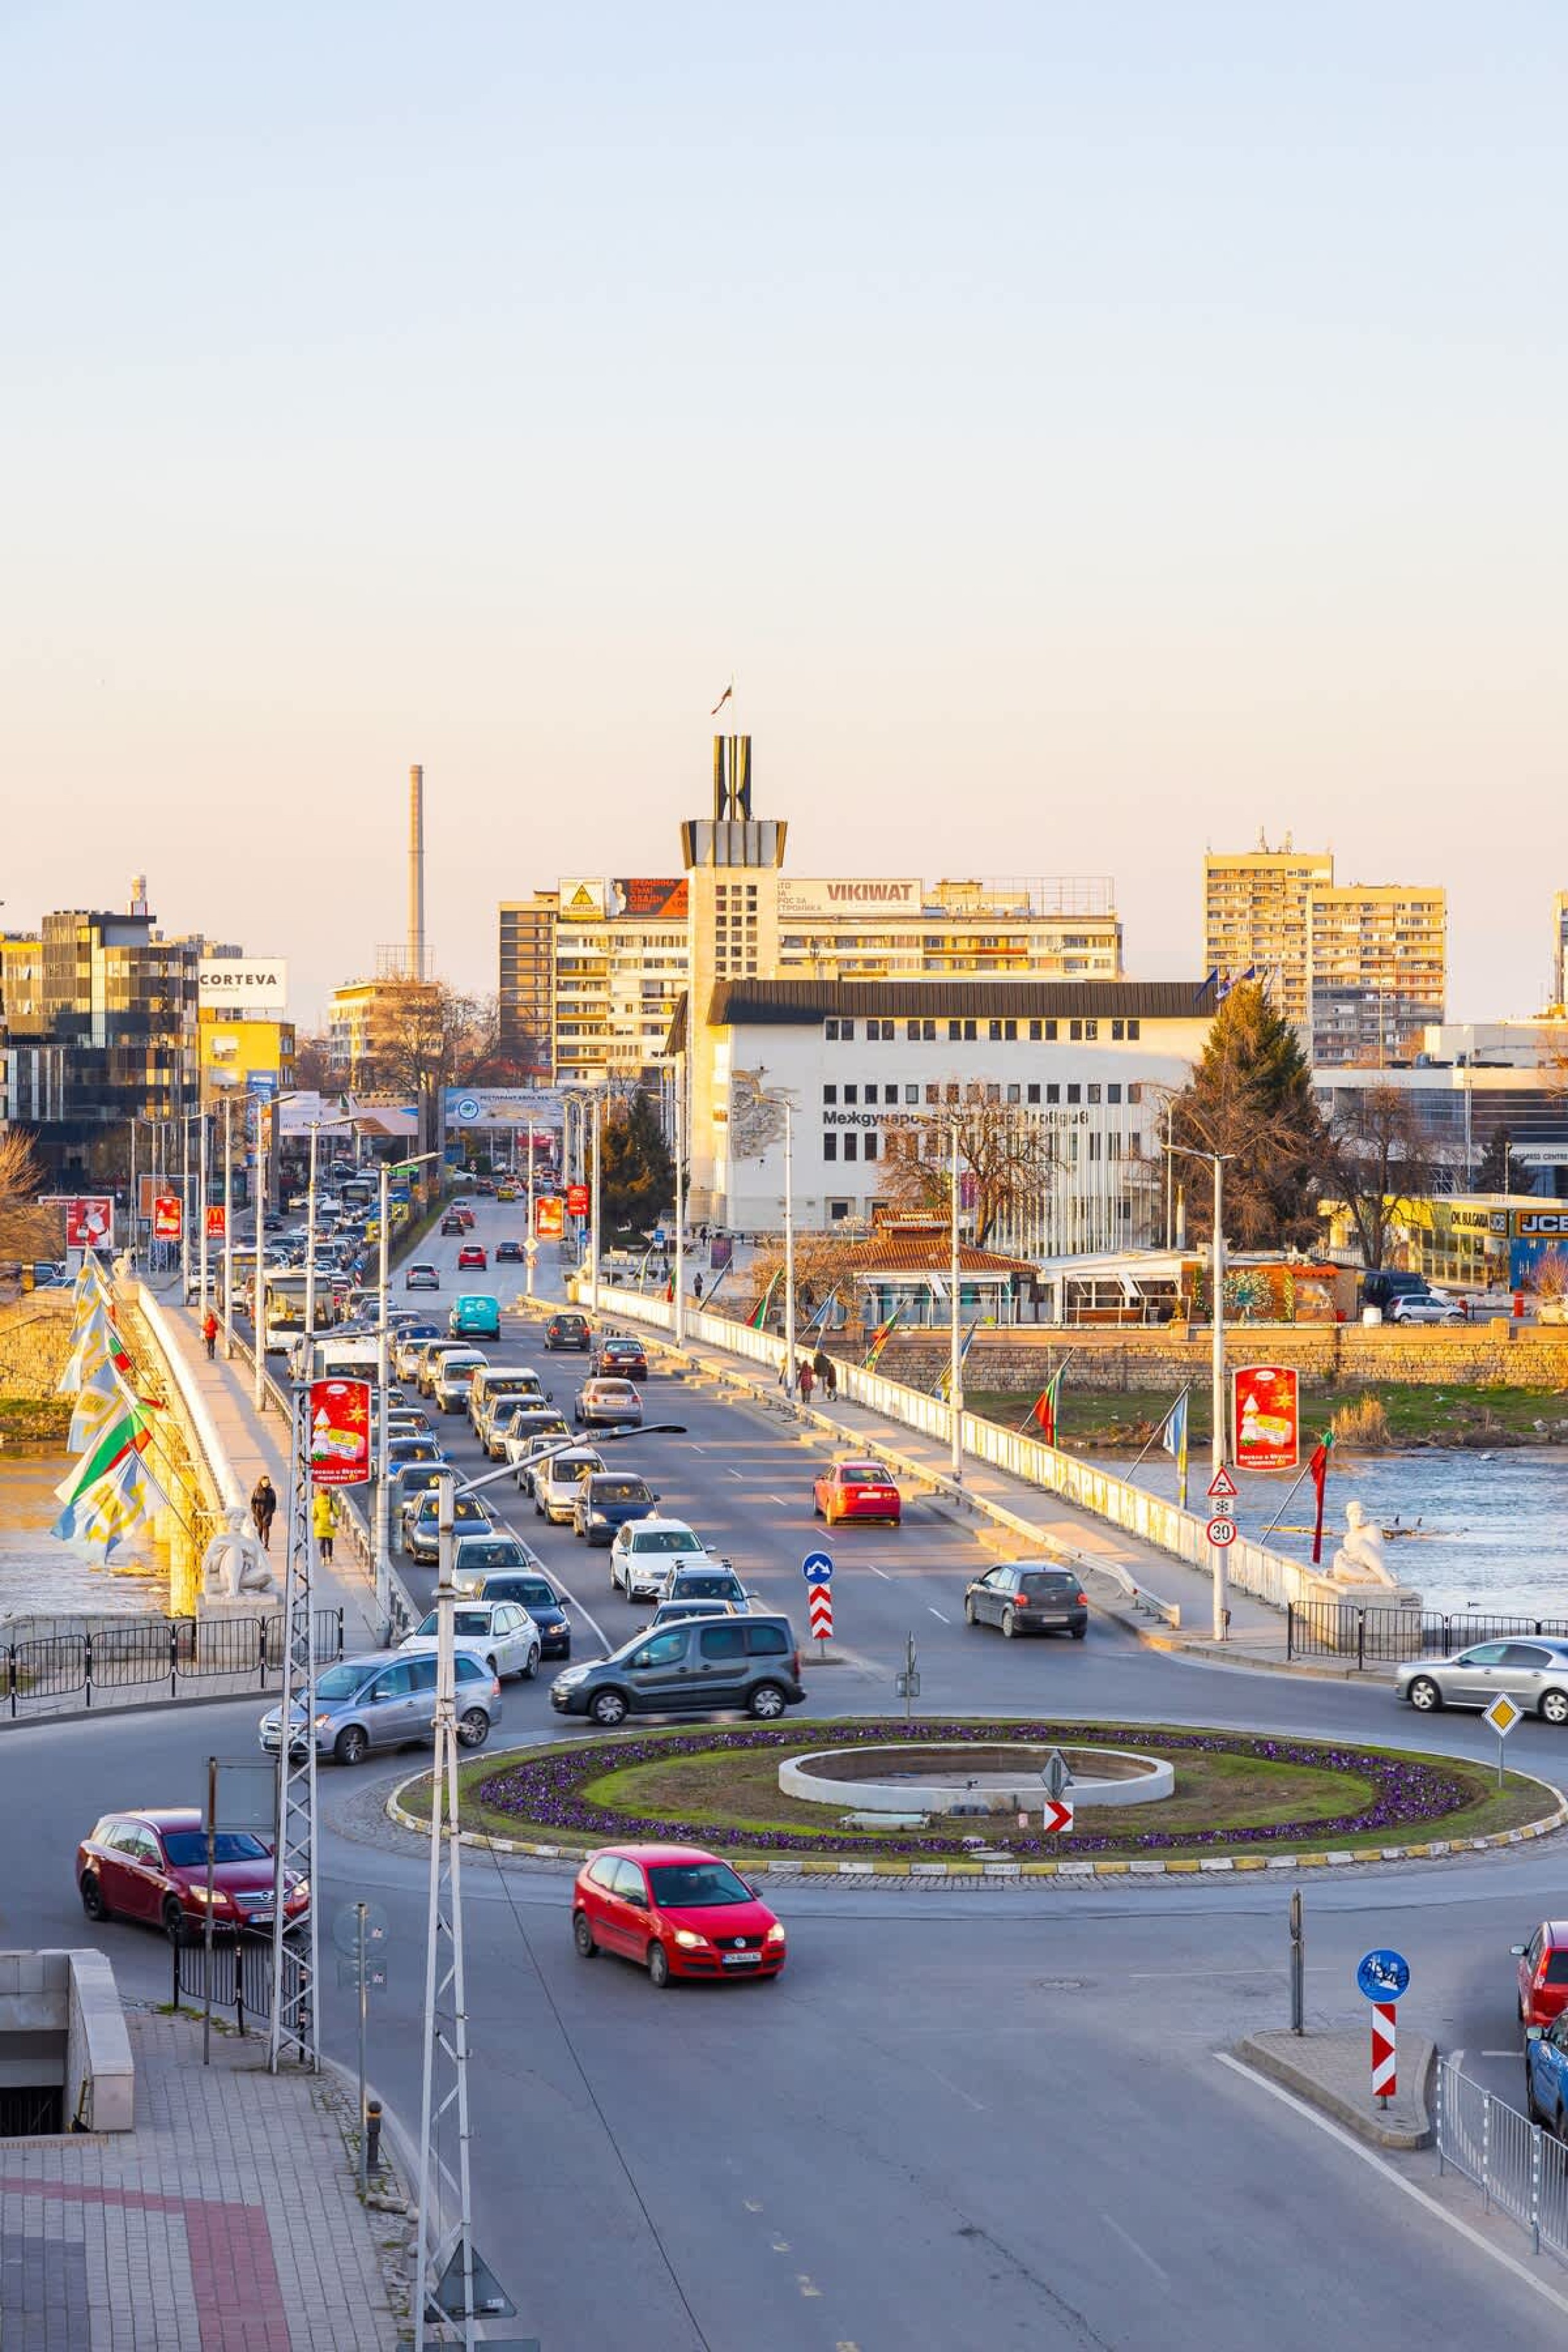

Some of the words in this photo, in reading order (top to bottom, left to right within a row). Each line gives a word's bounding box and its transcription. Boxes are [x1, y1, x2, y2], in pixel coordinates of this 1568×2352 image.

[827, 884, 913, 901] VIKIWAT
[200, 974, 277, 985] CORTEVA
[1213, 1525, 1230, 1540] 30
